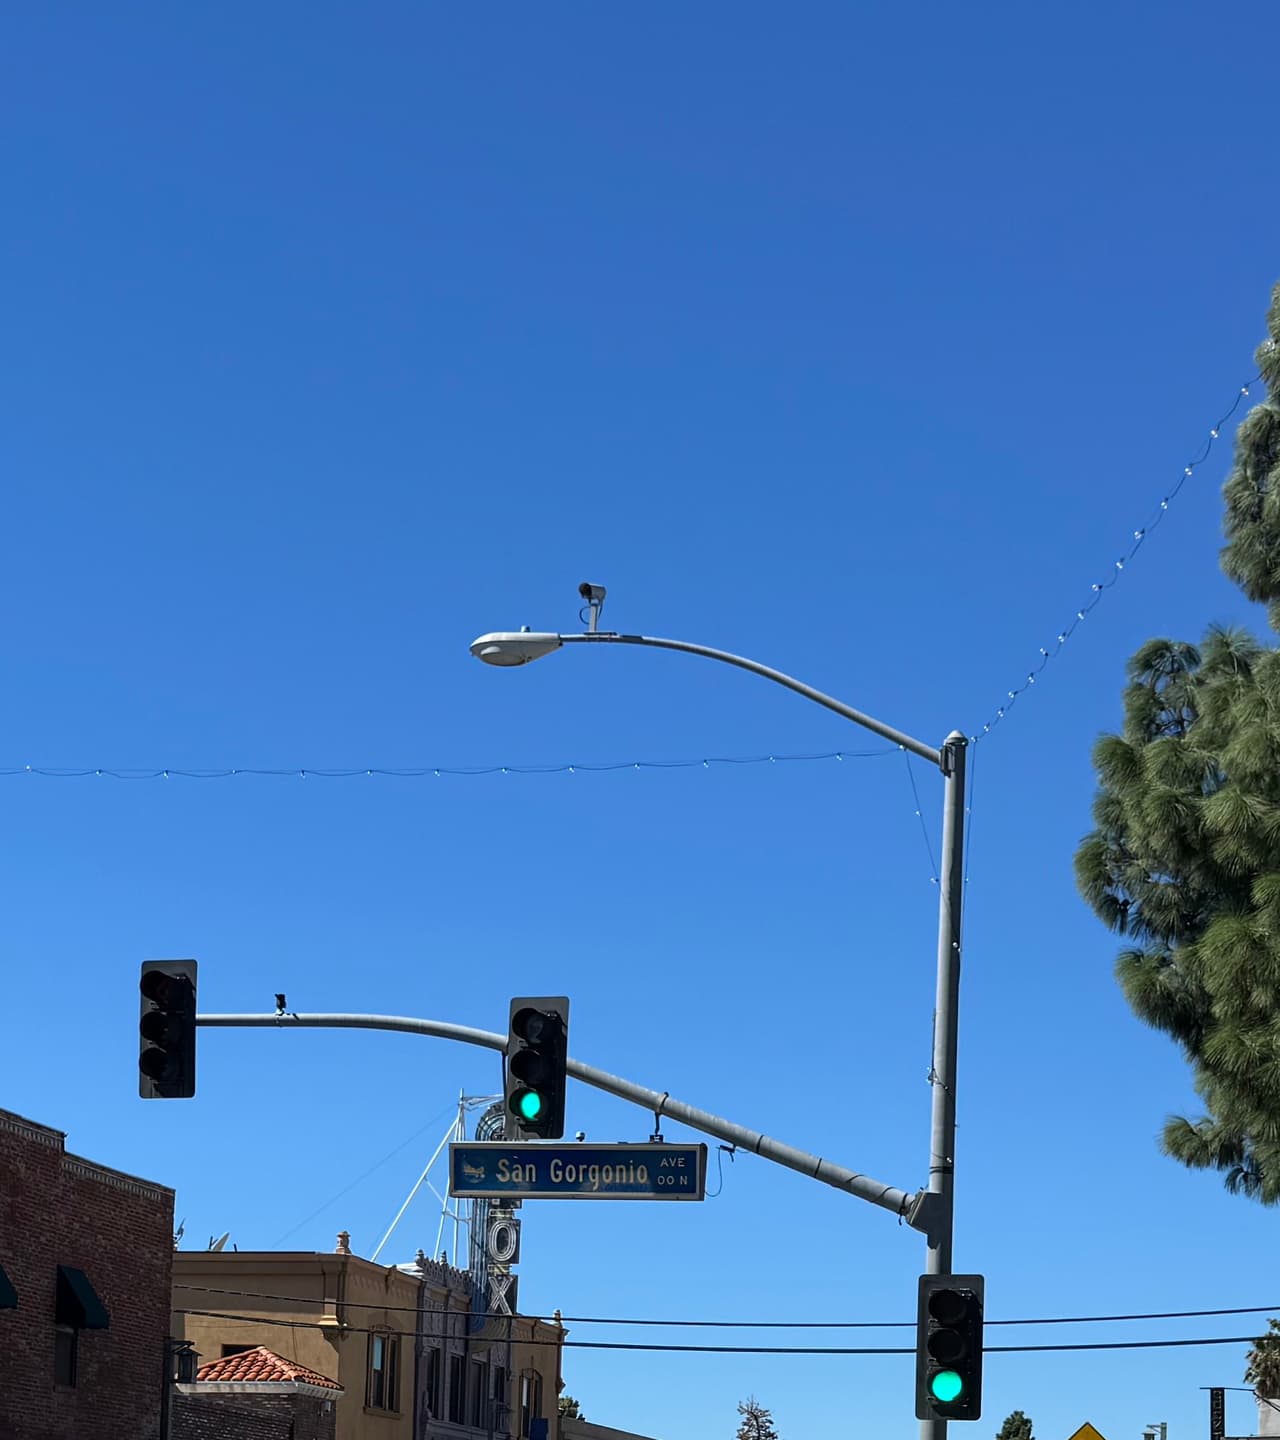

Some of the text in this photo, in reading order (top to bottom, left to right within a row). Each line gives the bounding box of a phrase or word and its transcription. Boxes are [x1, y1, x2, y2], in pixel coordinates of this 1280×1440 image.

[660, 1157, 686, 1168] AVE
[495, 1158, 649, 1190] San Gorgonio
[680, 1175, 688, 1185] N
[488, 1201, 518, 1316] OX
